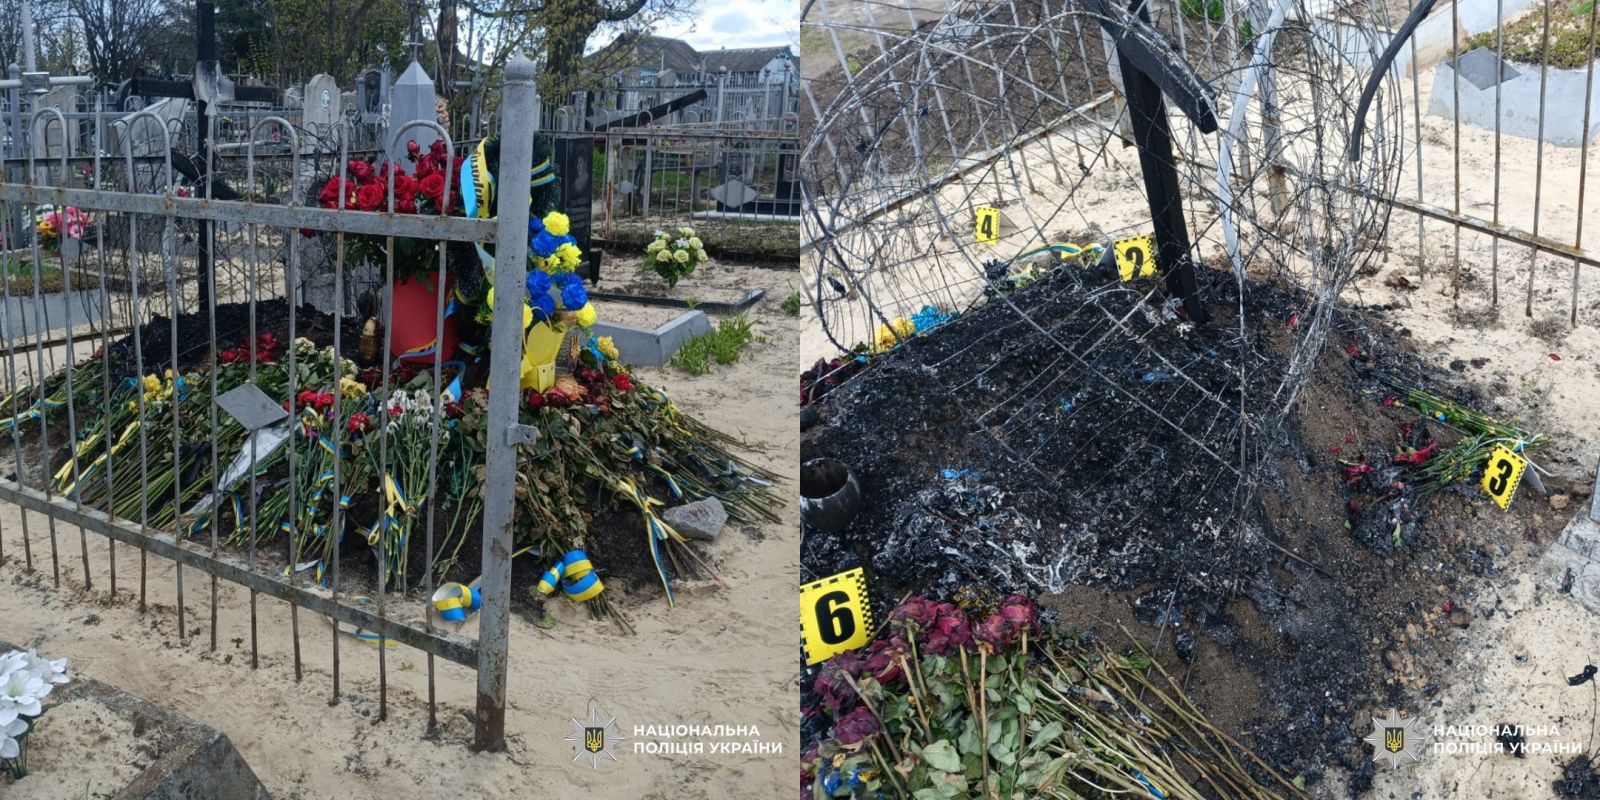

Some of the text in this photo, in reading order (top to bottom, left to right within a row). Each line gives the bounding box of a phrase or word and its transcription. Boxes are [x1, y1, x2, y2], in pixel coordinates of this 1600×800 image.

[980, 214, 993, 239] 4
[1125, 246, 1144, 281] 2
[1489, 459, 1513, 497] 3
[815, 591, 855, 645] 6
